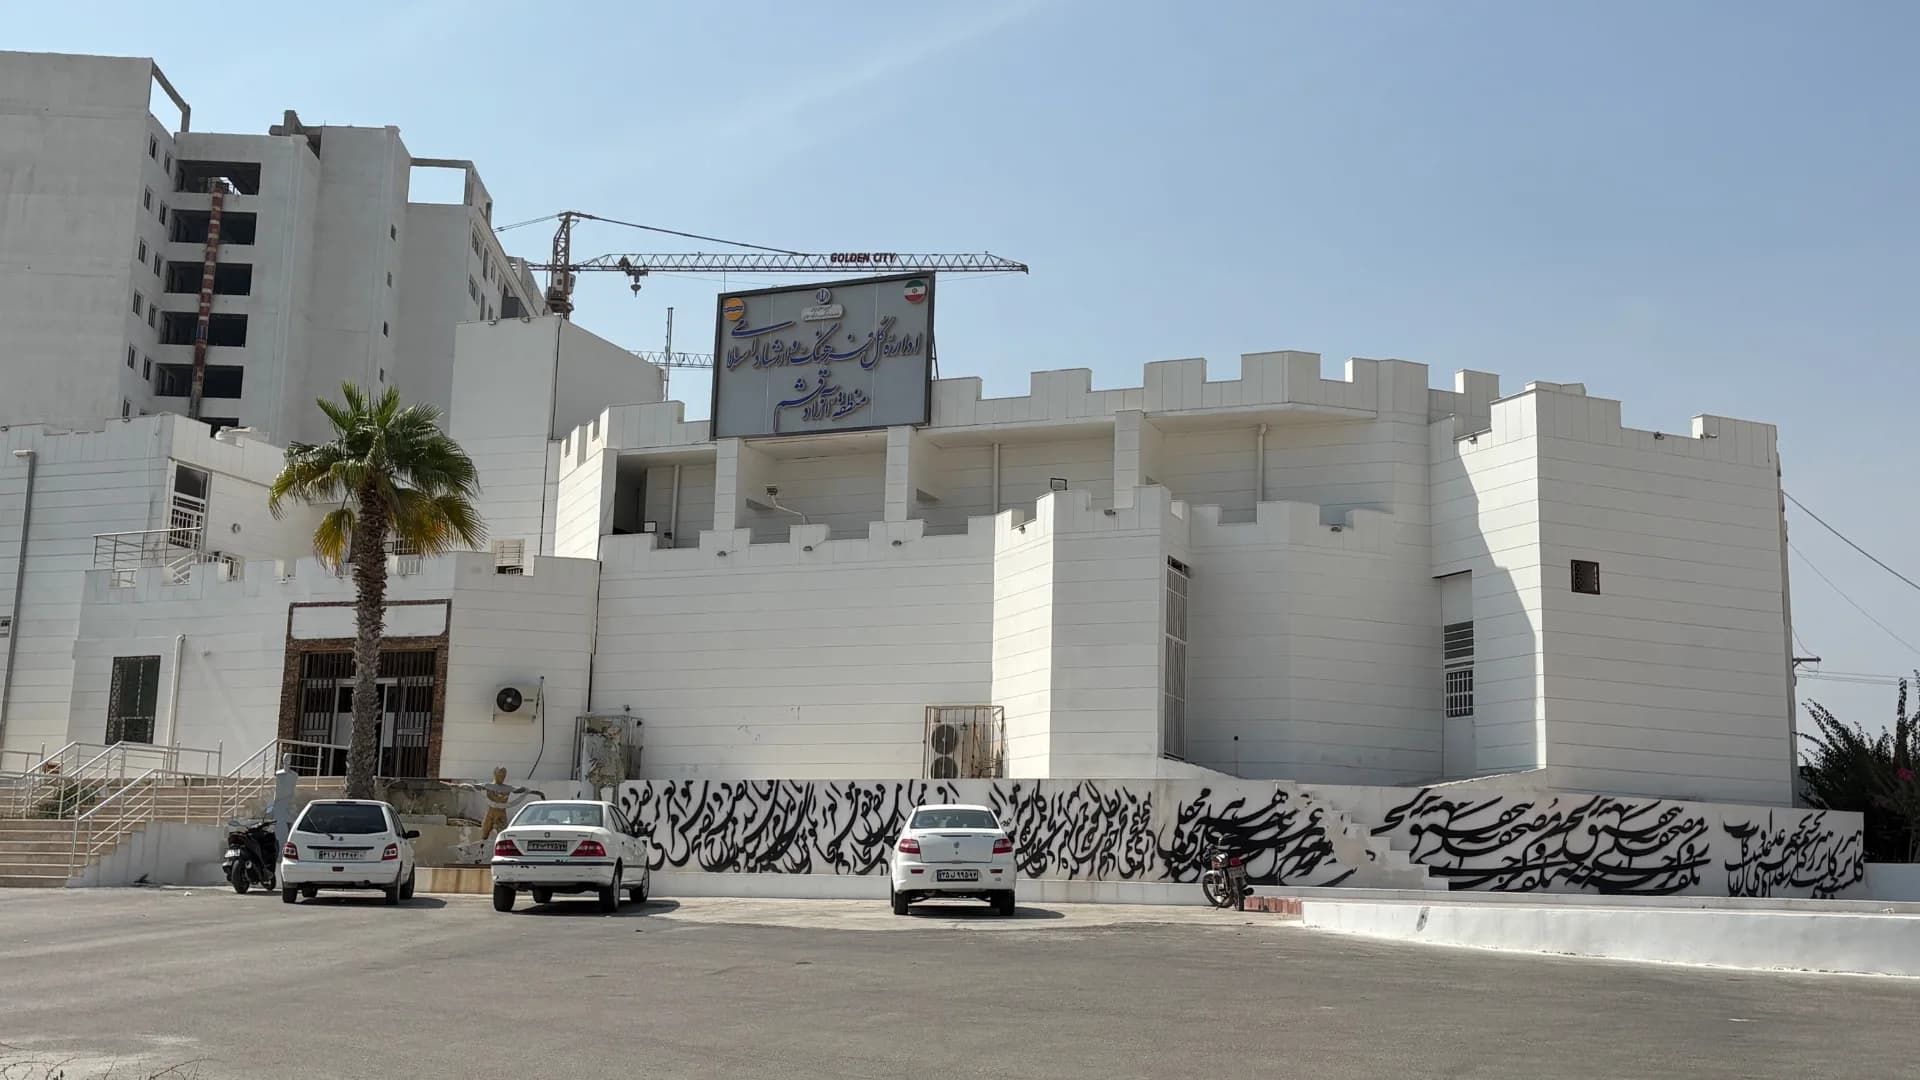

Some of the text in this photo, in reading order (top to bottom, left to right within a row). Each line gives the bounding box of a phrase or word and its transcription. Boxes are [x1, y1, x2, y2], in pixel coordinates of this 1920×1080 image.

[830, 252, 896, 263] GOLDEN CITY
[726, 319, 795, 369] اسلامی
[753, 338, 792, 368] ارشاد
[790, 322, 874, 365] فرهنگ
[773, 368, 869, 433] منطقه آزاد قشم
